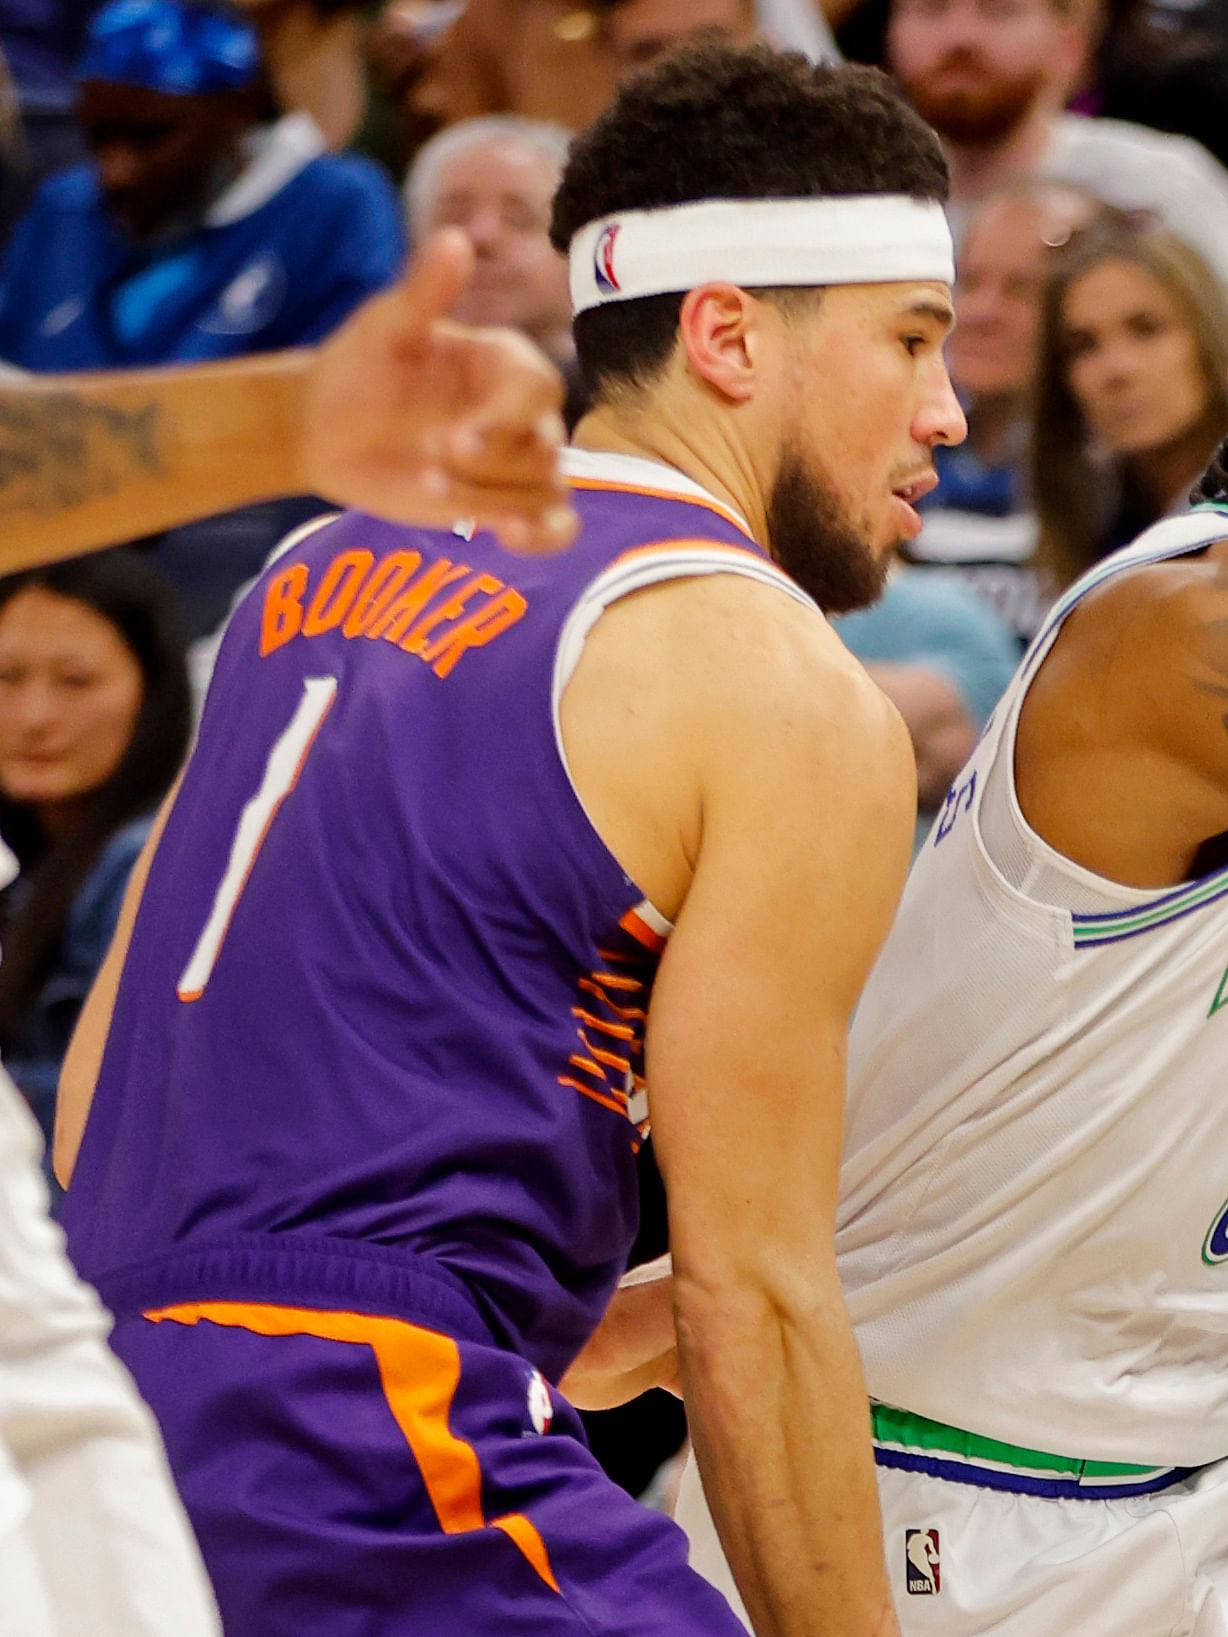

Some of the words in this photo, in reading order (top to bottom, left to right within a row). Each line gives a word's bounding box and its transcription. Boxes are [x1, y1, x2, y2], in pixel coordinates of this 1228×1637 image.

[259, 547, 529, 681] BOOKER
[176, 674, 338, 1003] 1
[909, 1580, 932, 1592] NBA
